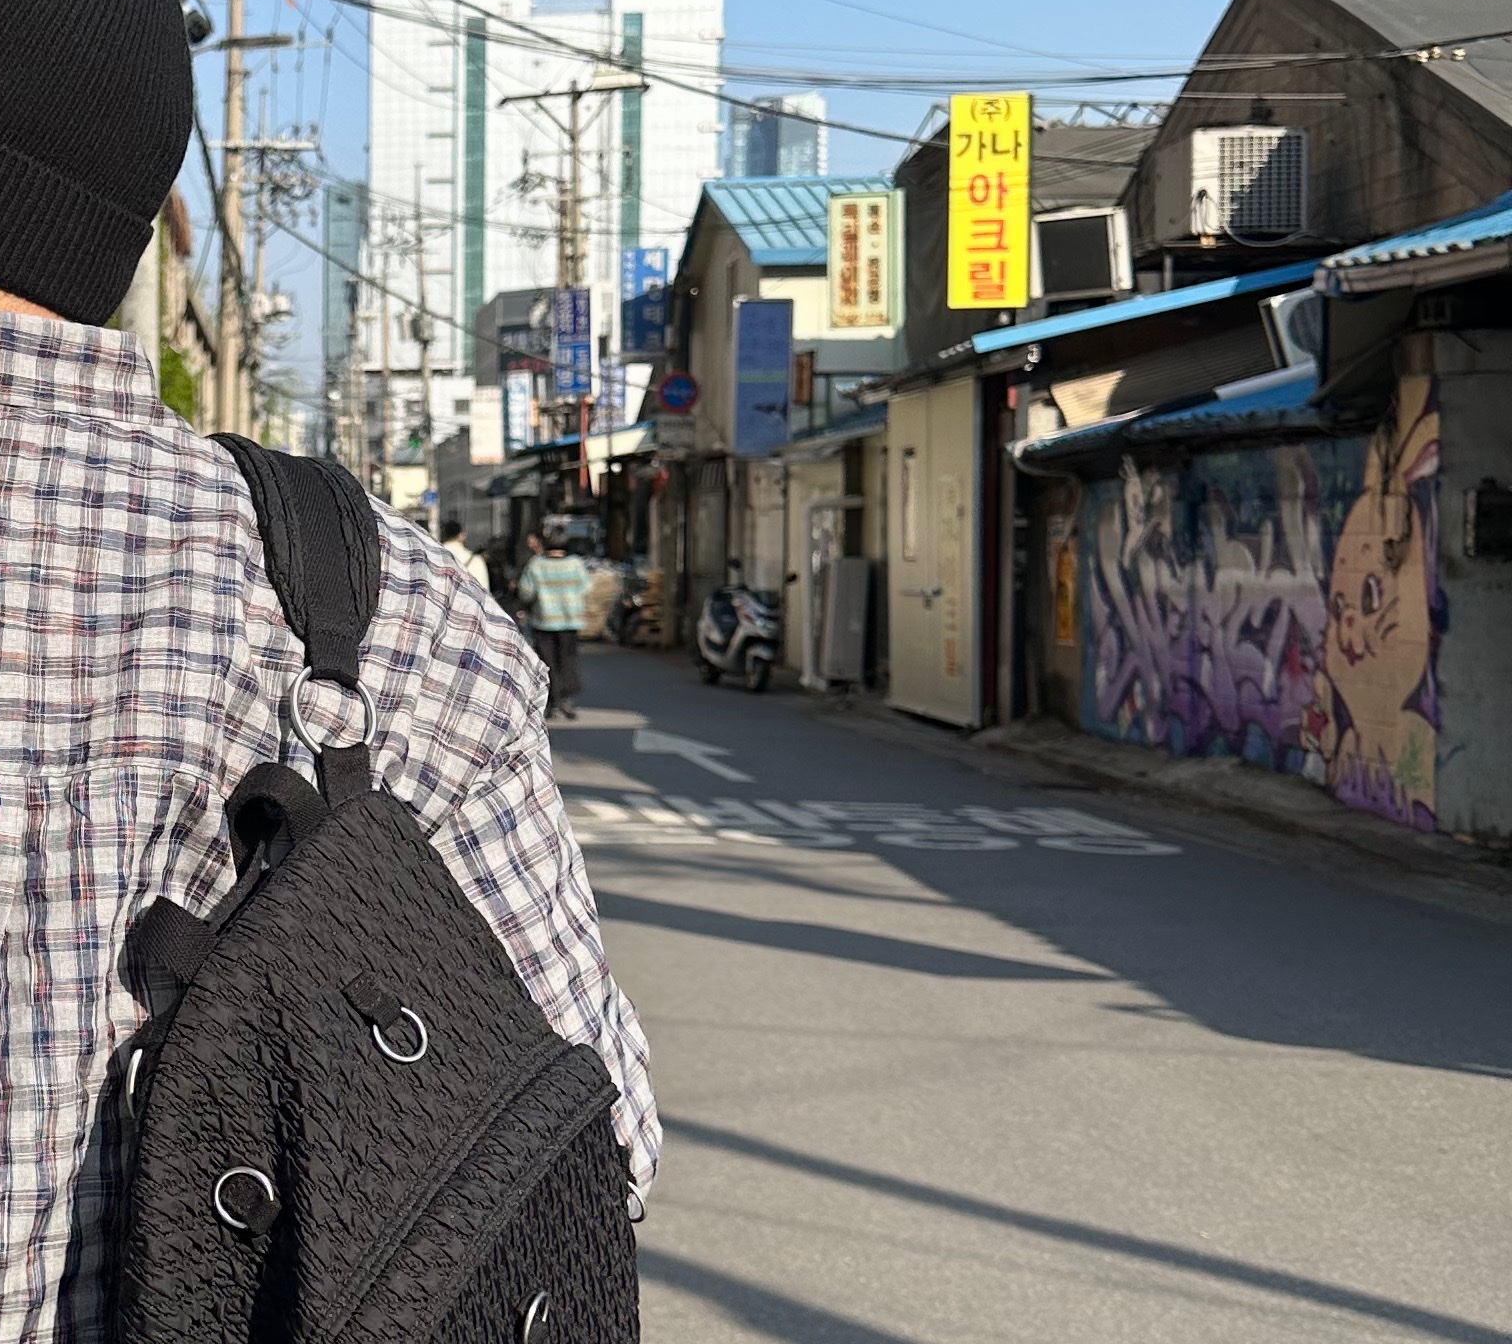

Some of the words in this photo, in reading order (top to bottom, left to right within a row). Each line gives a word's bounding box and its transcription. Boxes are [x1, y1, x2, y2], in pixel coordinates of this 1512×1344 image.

[970, 98, 1012, 123] (주)
[955, 130, 1023, 162] 가나
[966, 171, 1009, 301] 아크릴
